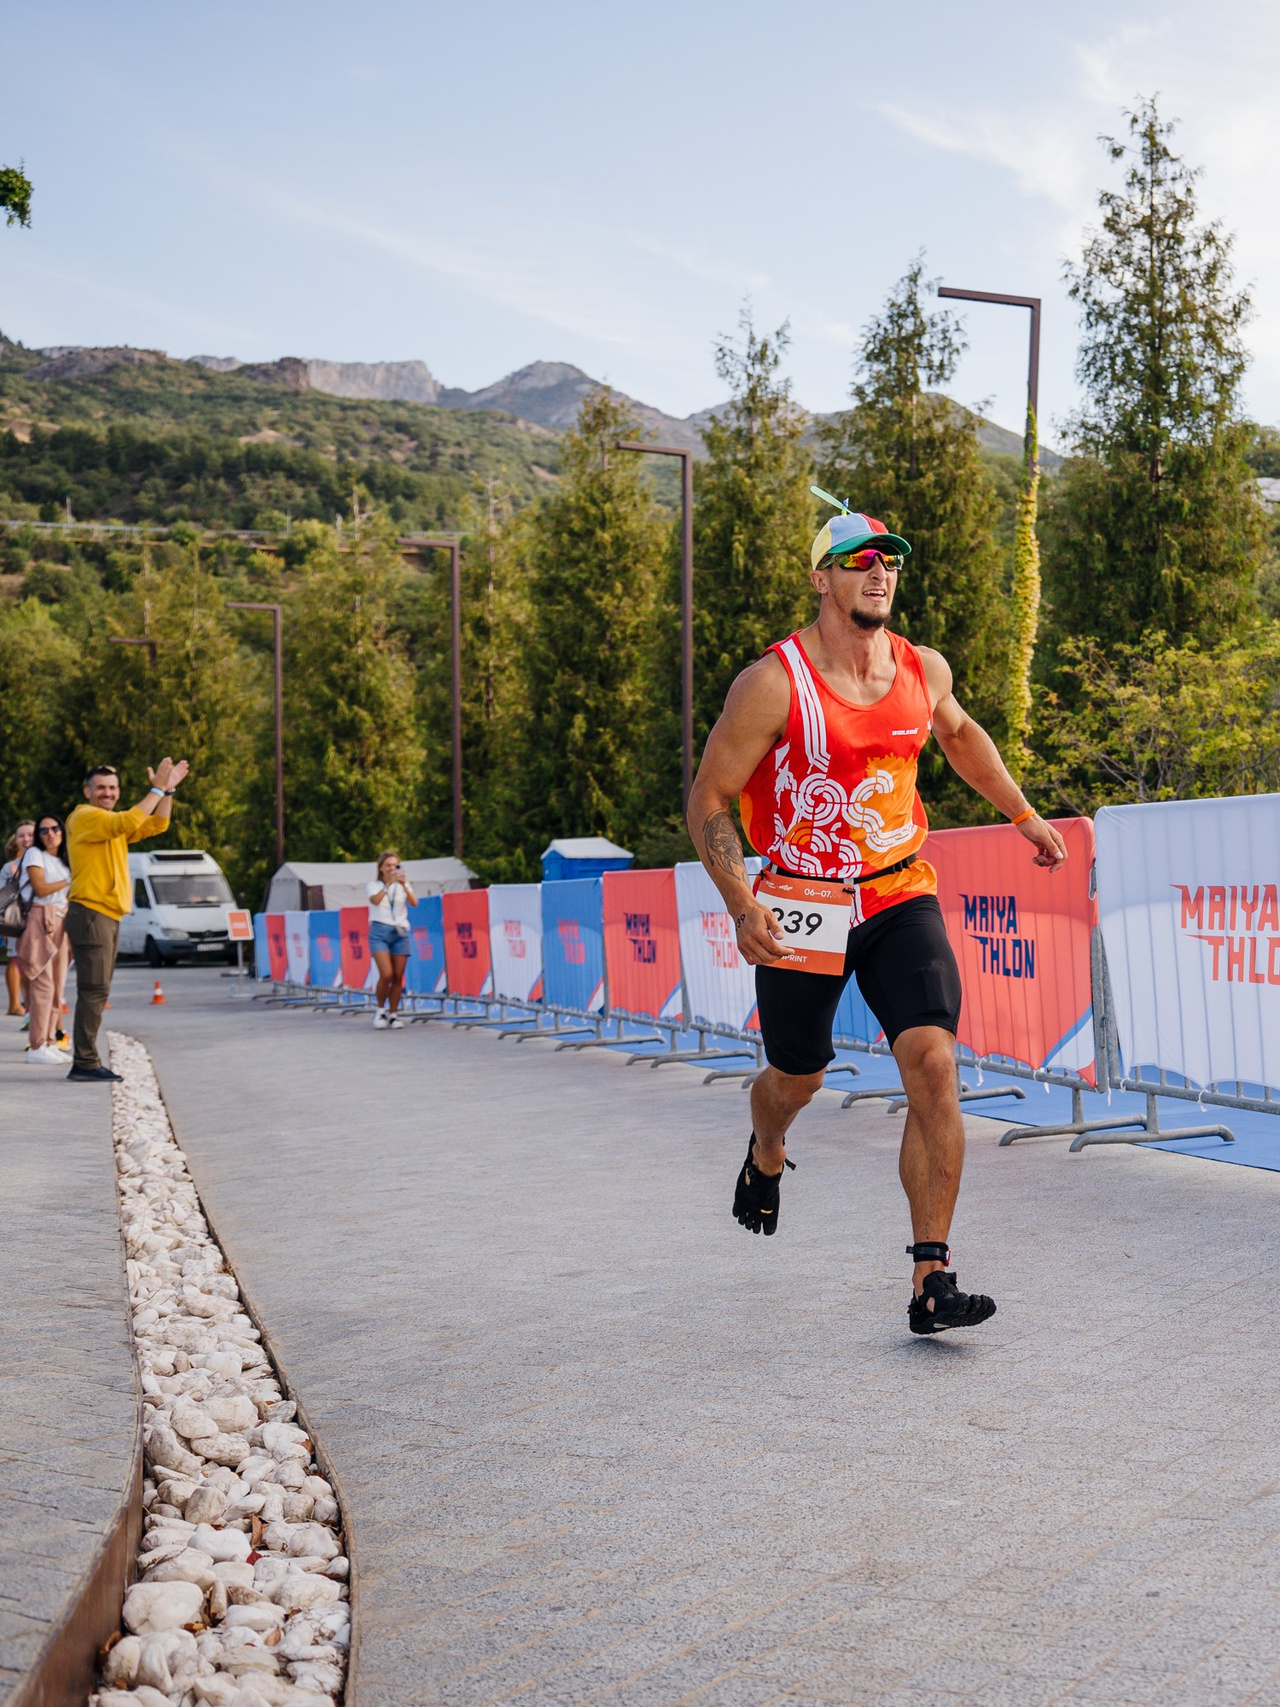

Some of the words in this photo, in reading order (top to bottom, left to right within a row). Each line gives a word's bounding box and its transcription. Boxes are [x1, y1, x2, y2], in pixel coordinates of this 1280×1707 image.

[957, 893, 1018, 934] MRIYA
[1168, 884, 1280, 931] MRIYA
[966, 934, 1035, 979] THLON
